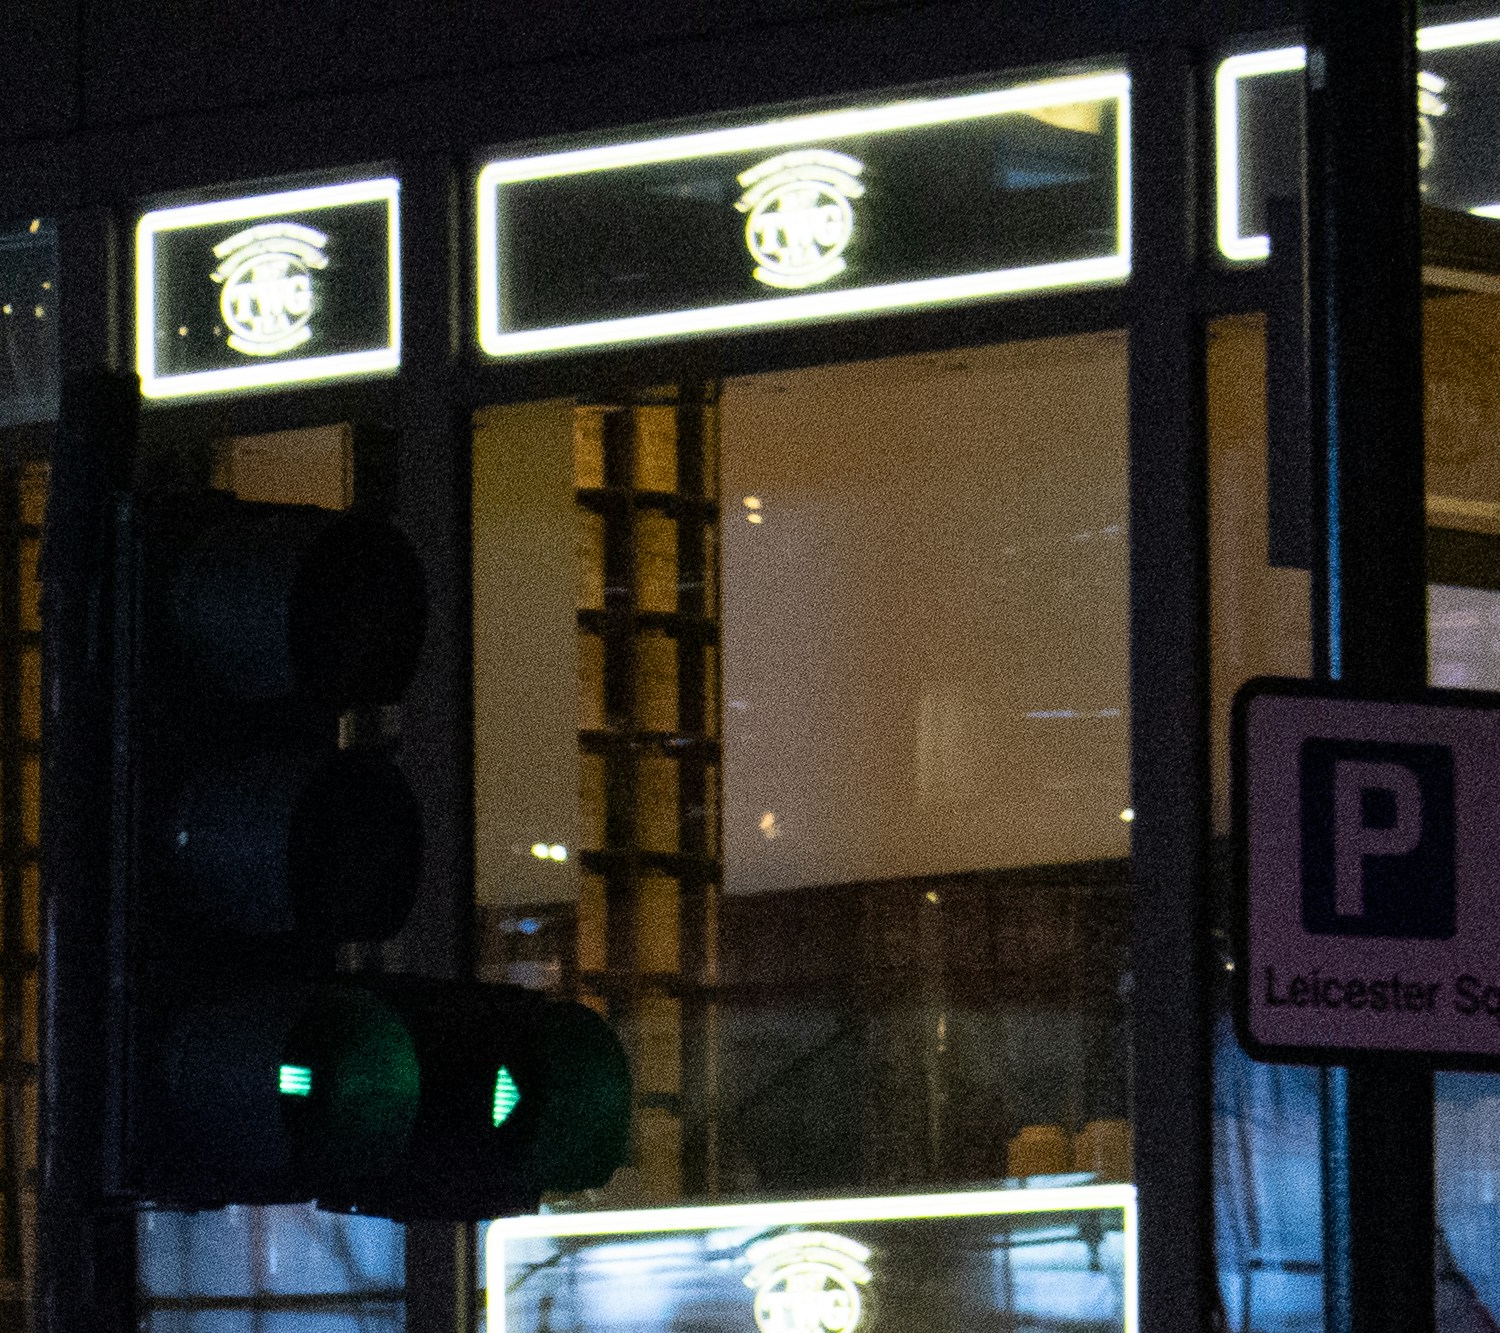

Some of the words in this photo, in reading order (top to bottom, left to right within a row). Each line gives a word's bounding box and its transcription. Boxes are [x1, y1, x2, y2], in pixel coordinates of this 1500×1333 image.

[752, 205, 846, 253] TWG
[229, 276, 312, 322] TWG
[1333, 759, 1424, 918] P
[1263, 965, 1440, 1012] Leicester
[761, 1289, 851, 1332] TWG
